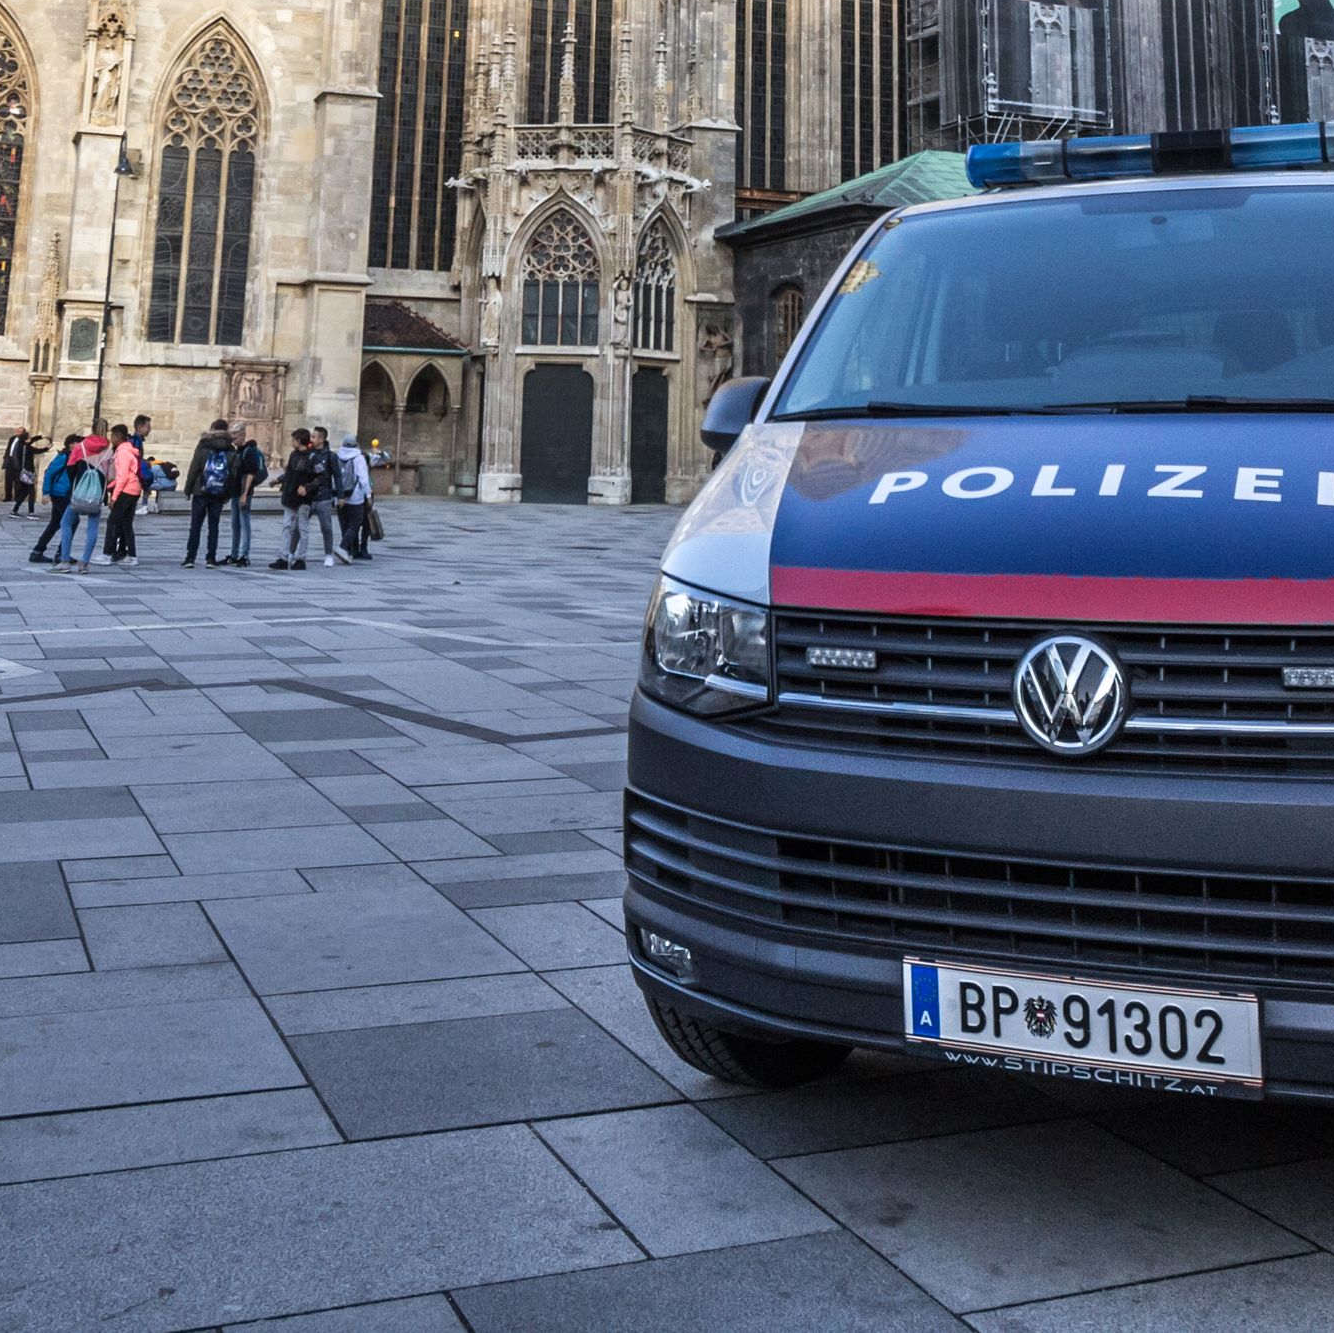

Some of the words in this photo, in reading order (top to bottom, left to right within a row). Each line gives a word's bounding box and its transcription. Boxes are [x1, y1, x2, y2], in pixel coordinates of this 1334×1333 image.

[919, 1010, 934, 1027] A
[959, 981, 1019, 1038] BP
[1062, 994, 1226, 1065] 91302
